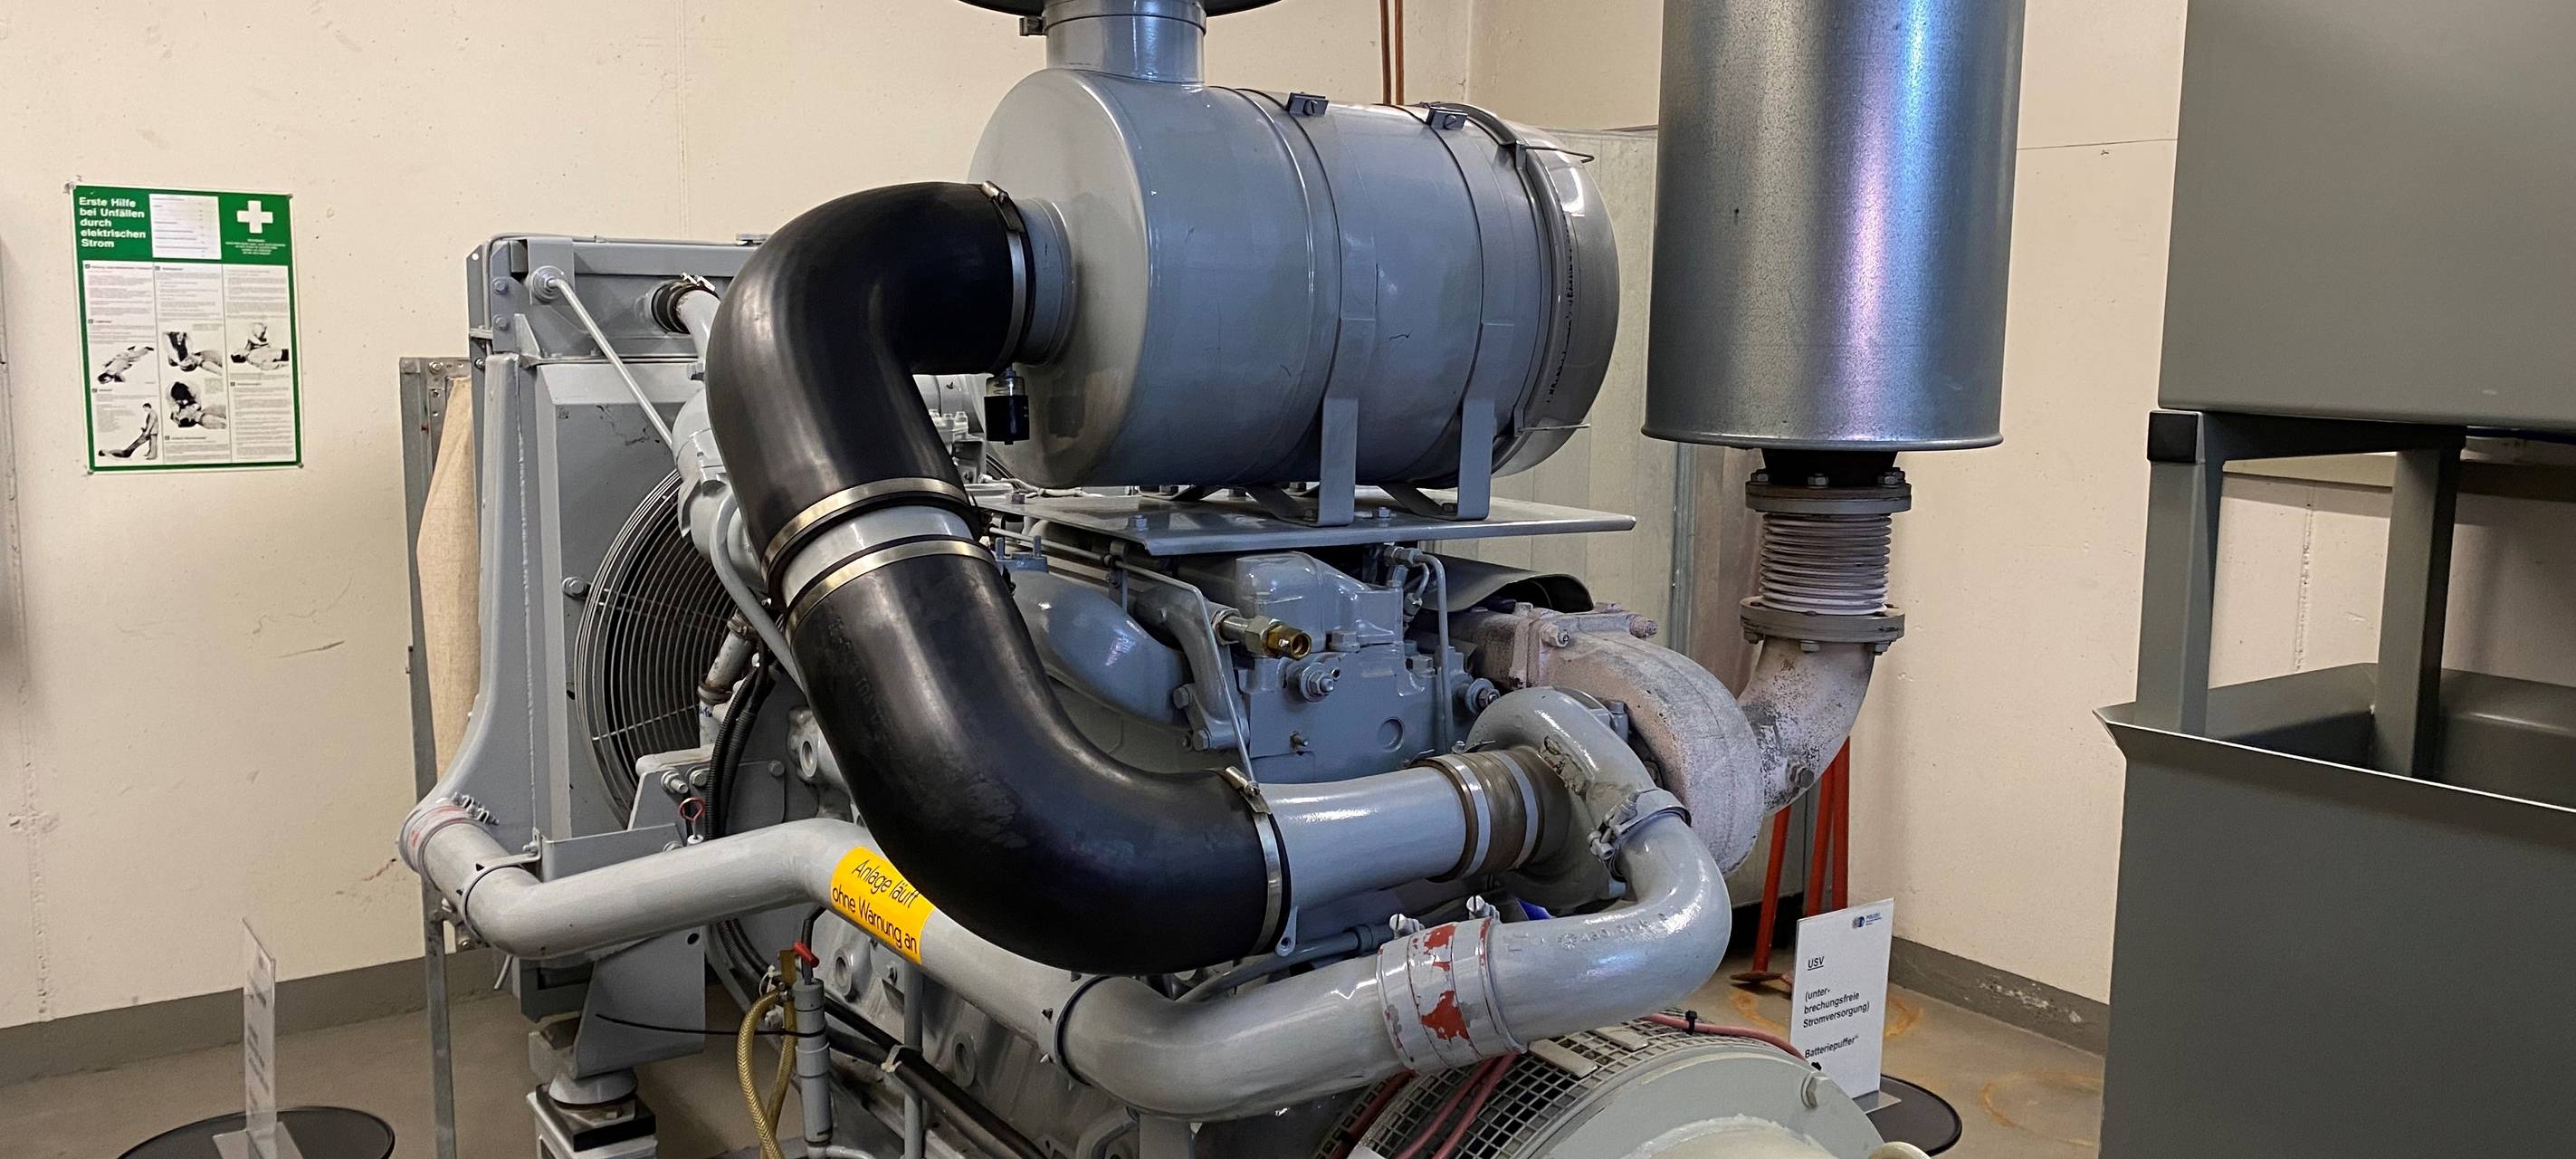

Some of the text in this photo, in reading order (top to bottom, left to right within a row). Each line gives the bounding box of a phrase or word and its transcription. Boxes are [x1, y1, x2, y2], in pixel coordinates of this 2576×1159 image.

[79, 196, 136, 208] Erste Hilfe
[80, 208, 145, 218] bei Unfällen
[80, 218, 112, 227] durch
[80, 228, 147, 239] elektrischen
[81, 238, 115, 248] Strom
[851, 858, 920, 908] Anlage läuft
[832, 884, 918, 954] ohne Warnung an
[1808, 955, 1825, 969] USV
[1805, 986, 1831, 1002] (unter-
[1804, 991, 1860, 1015] brechungsfreie
[1802, 1001, 1870, 1029] Stromversorgung)
